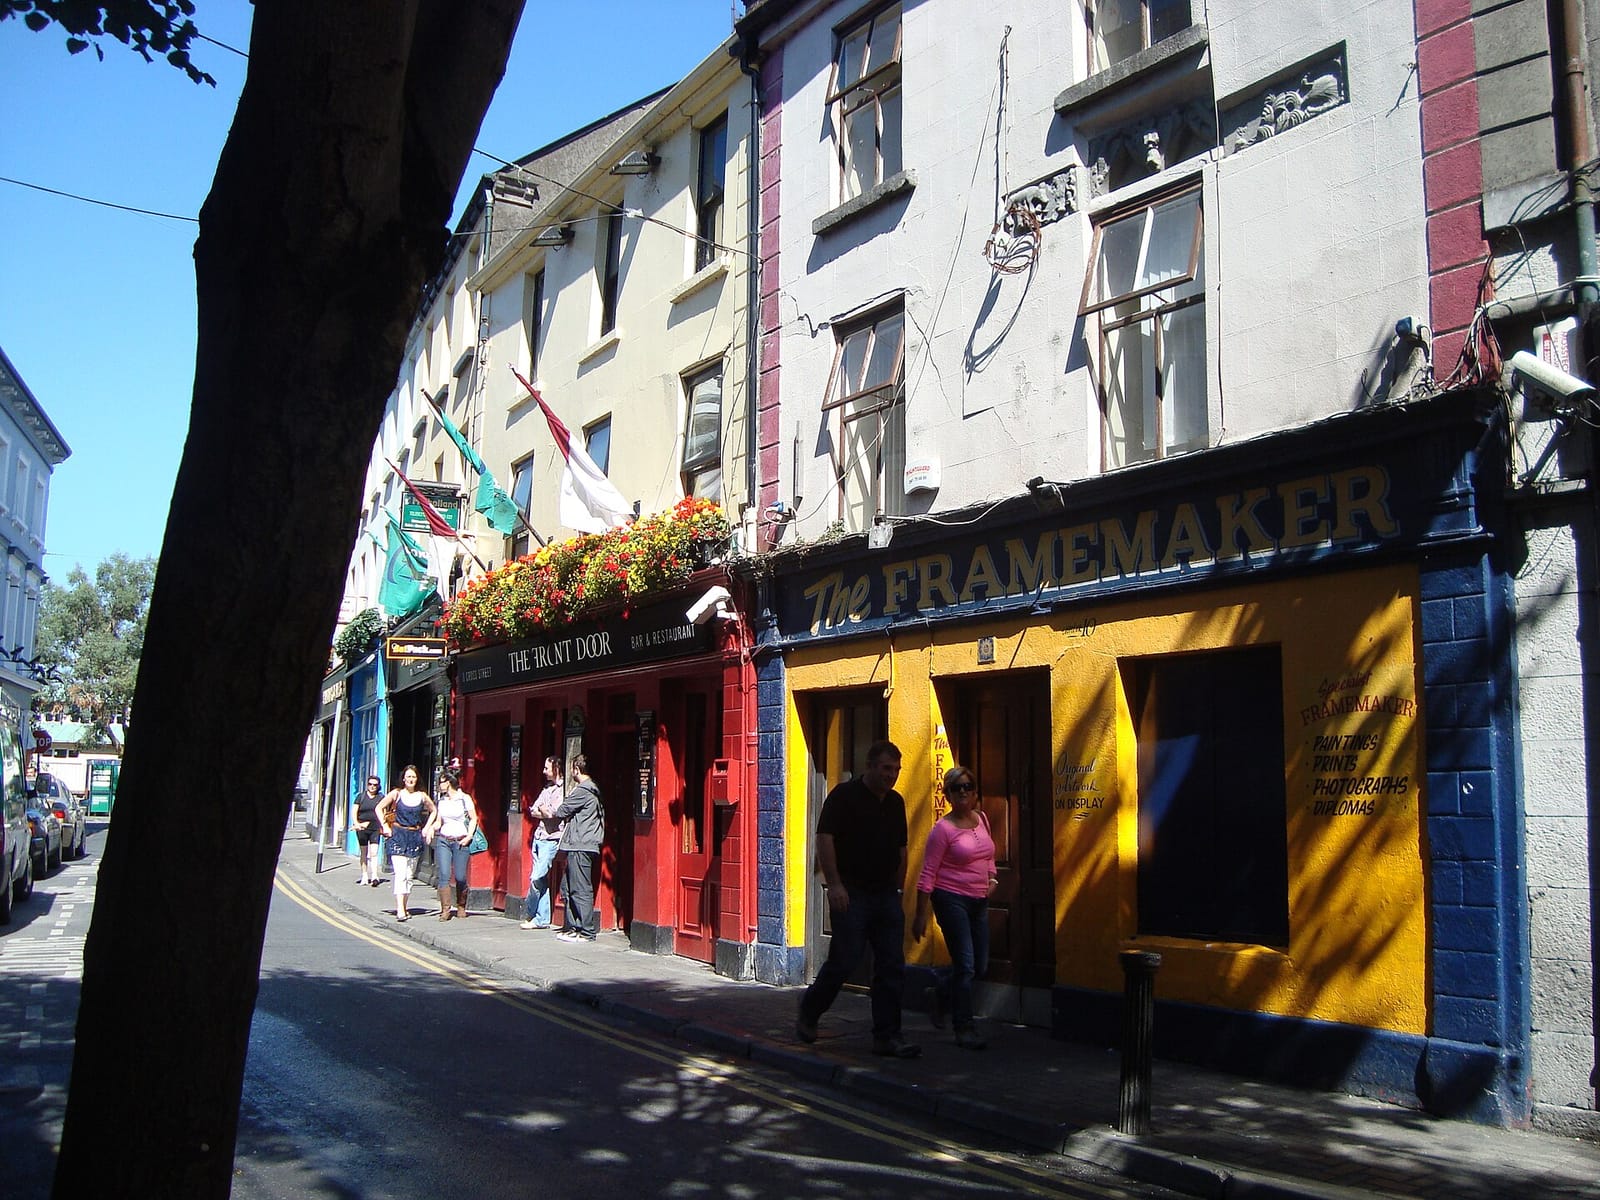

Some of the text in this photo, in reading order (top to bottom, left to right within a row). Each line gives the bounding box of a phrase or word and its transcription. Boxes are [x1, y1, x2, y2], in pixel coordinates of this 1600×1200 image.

[803, 464, 1402, 636] The FRAMEMAKER
[630, 623, 696, 650] BAR & RESTAURANT
[1080, 617, 1097, 637] 10
[508, 649, 531, 673] THE
[576, 631, 614, 661] DOOR
[1317, 672, 1372, 699] Specialist
[1300, 694, 1415, 726] FRAMEMAKER
[934, 736, 950, 750] The
[1312, 735, 1378, 752] PAINTINGS
[1057, 750, 1096, 777] Original
[1312, 754, 1358, 773] PRINTS
[1312, 775, 1408, 796] PHOTOGRAPHS
[1055, 797, 1105, 810] ON DISPLAY
[1312, 799, 1375, 817] DIPLOMAS
